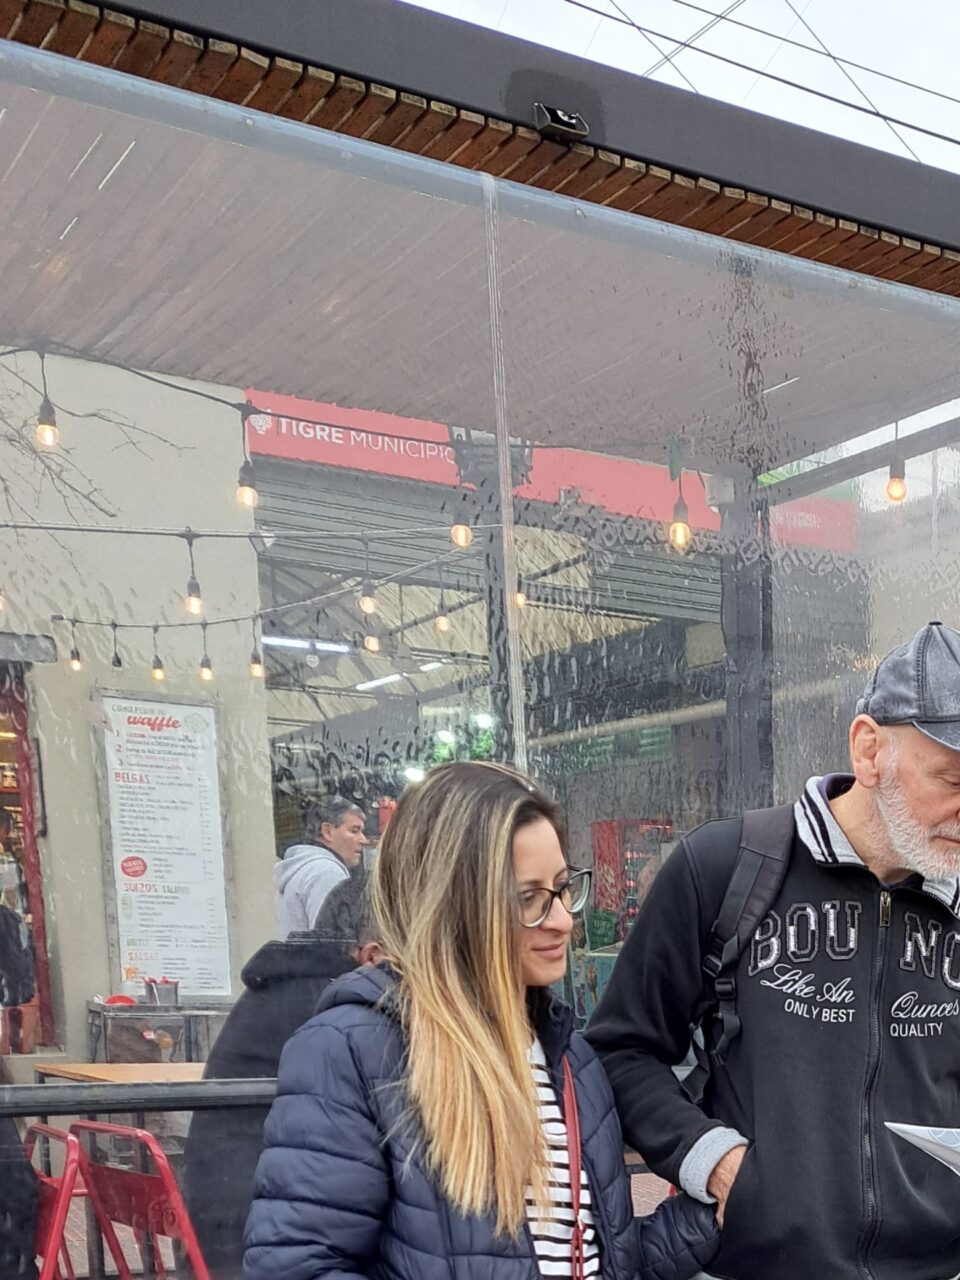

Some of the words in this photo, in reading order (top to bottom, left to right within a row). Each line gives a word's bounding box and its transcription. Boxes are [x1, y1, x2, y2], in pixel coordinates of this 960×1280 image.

[278, 416, 344, 444] TIGRE
[126, 715, 182, 732] waffle
[113, 771, 151, 785] BELGAS
[123, 882, 158, 893] SUIZOS
[759, 963, 815, 999] Like
[816, 977, 856, 1004] An
[784, 998, 820, 1020] ONLY
[821, 1008, 856, 1023] BEST
[889, 1022, 943, 1037] QUALITY
